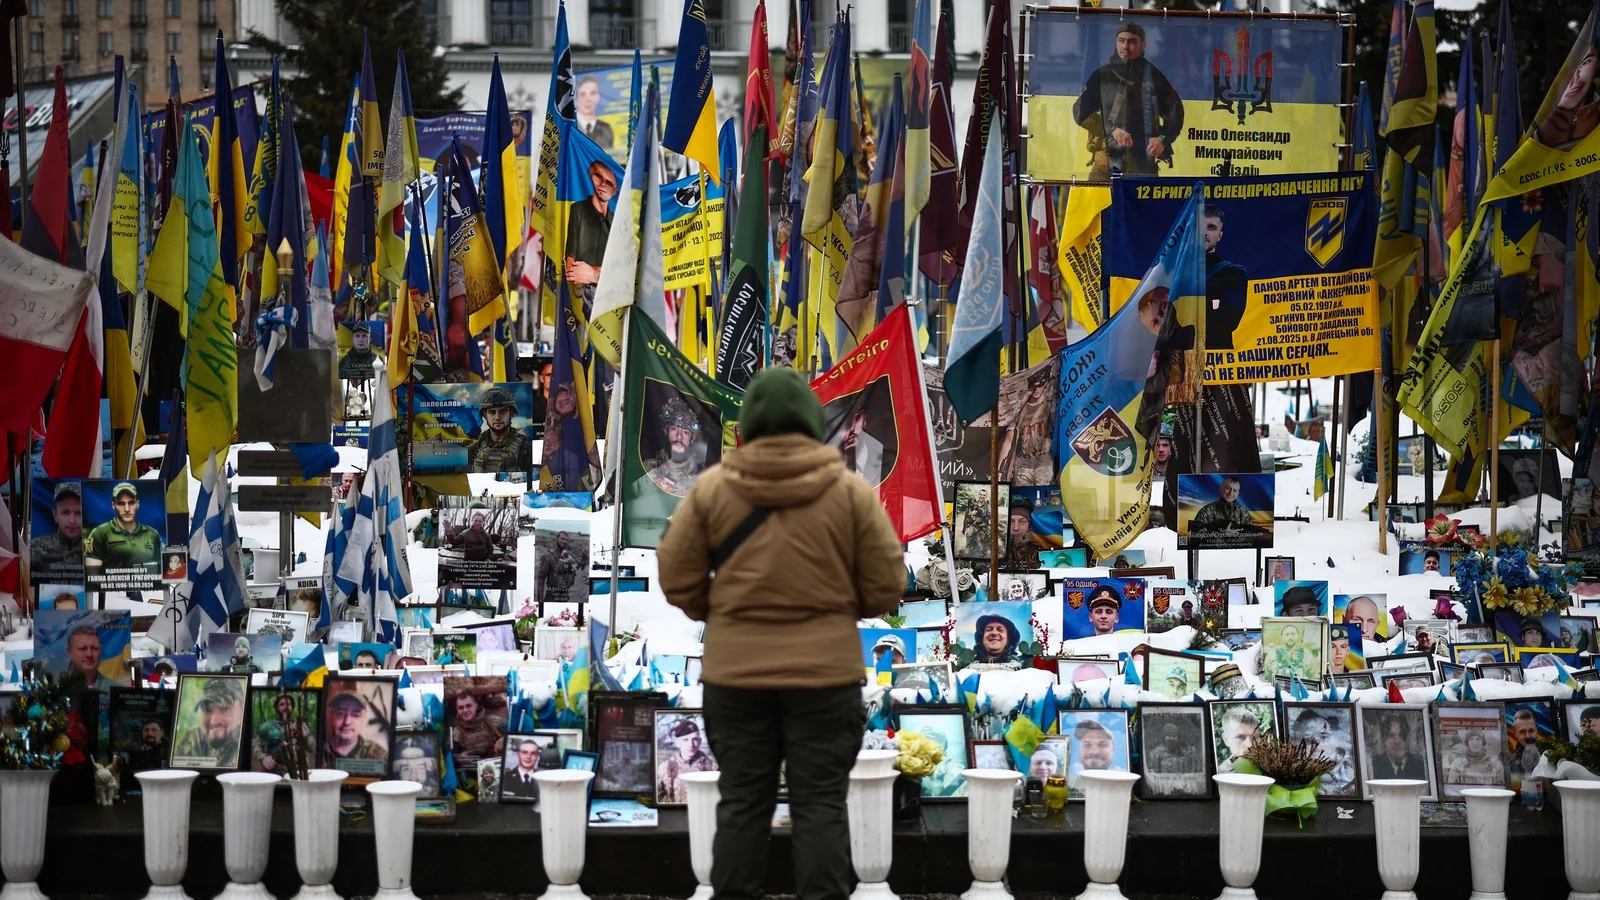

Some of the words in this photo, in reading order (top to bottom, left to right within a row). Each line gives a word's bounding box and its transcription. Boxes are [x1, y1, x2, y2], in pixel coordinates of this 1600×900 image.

[1188, 128, 1218, 141] Янко
[1220, 128, 1291, 144] Олександр
[1195, 146, 1283, 161] Миколайович
[1210, 164, 1260, 178] «Зізді»
[1136, 186, 1150, 200] 12
[1152, 186, 1211, 200] БРИГАА
[1214, 178, 1339, 200] СПЕЦПРИЗНАЧЕННЯ
[1341, 176, 1365, 191] НГУ
[1312, 202, 1344, 210] АЗОВ
[1254, 281, 1286, 294] ПАНОВ
[1288, 278, 1319, 290] АРТЕМ
[1264, 288, 1315, 304] ПОЗИВНИЙ
[1316, 284, 1371, 300] «АККЕРМАН»
[1290, 302, 1332, 312] 05.02.1997
[1269, 314, 1306, 324] ЗАГИНУВ
[1306, 311, 1322, 322] ПРИ
[1324, 307, 1364, 320] ВИКОНАННІ
[1276, 321, 1318, 334] БОЙОВОГО
[1319, 318, 1358, 331] ЗАВДАННЯ
[1256, 334, 1300, 346] 21.08.2025
[1316, 328, 1359, 343] ДОНЕЦЬКІЙ
[1228, 351, 1236, 364] В
[1238, 346, 1284, 363] НАШИХ
[1286, 342, 1339, 361] СЕРЦЯХ...
[1218, 366, 1234, 380] НЕ
[1236, 362, 1310, 378] ВМИРАЮТЬ!
[298, 580, 318, 588] KOIRA
[1066, 580, 1076, 588] 95
[1076, 581, 1098, 589] ОДШБр
[1162, 588, 1184, 596] ОДШБр
